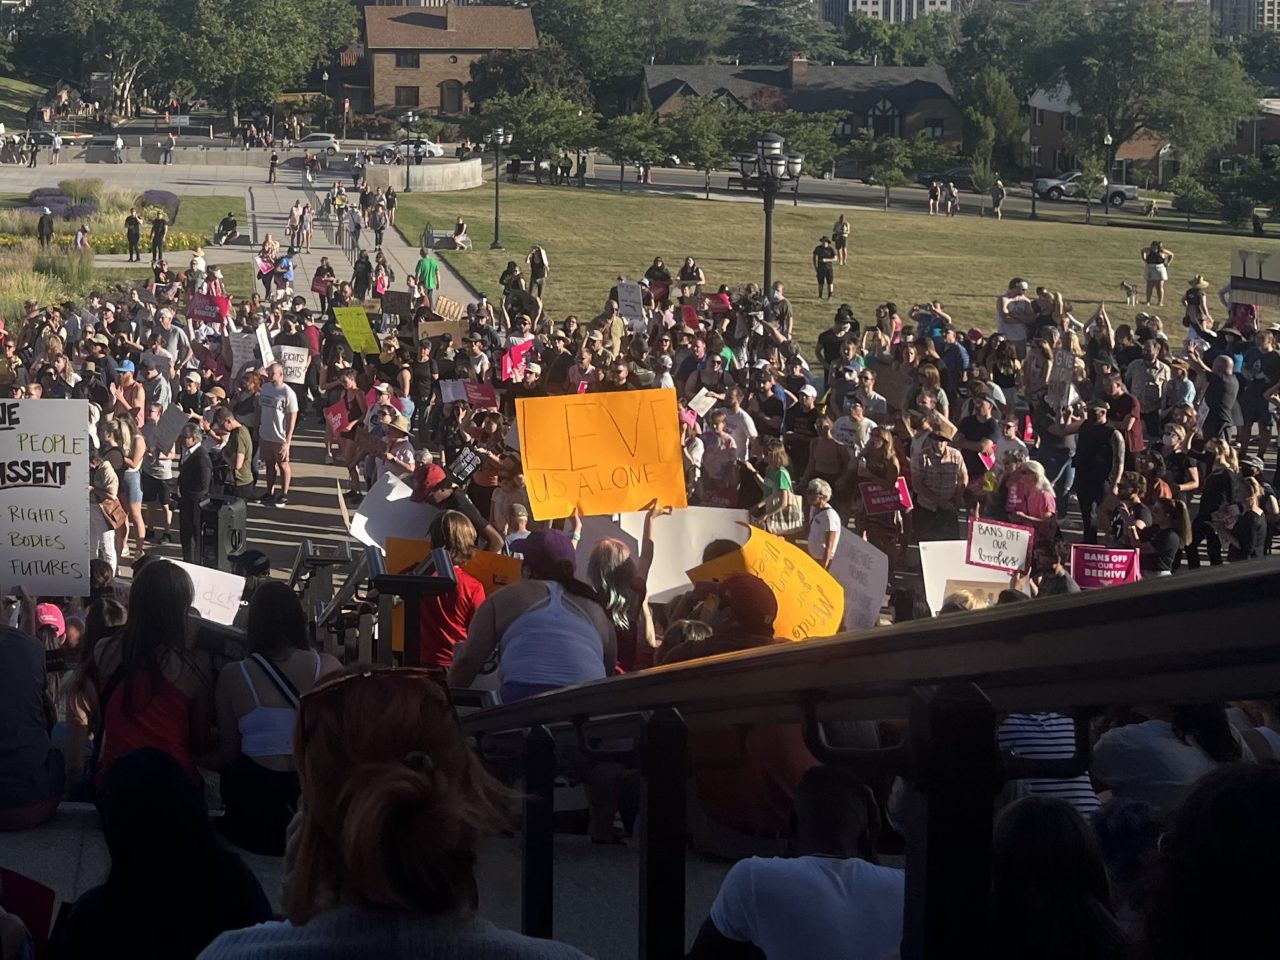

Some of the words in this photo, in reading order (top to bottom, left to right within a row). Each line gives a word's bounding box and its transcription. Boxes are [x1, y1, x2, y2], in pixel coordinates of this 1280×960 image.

[283, 352, 305, 363] RIGHTS
[17, 432, 85, 455] PEOPLE
[529, 472, 568, 503] US
[578, 463, 656, 498] ALONE
[8, 505, 68, 524] RIGHTS
[8, 531, 66, 550] BODIES
[977, 524, 1003, 539] BANS
[1006, 530, 1021, 540] OFF
[992, 541, 1008, 550] OUR
[978, 547, 1019, 567] bodies
[1084, 552, 1110, 562] BANS
[1111, 554, 1128, 563] OFF
[10, 558, 83, 578] FUTURES
[1084, 568, 1127, 579] BEEHIVE
[202, 584, 235, 607] dick
